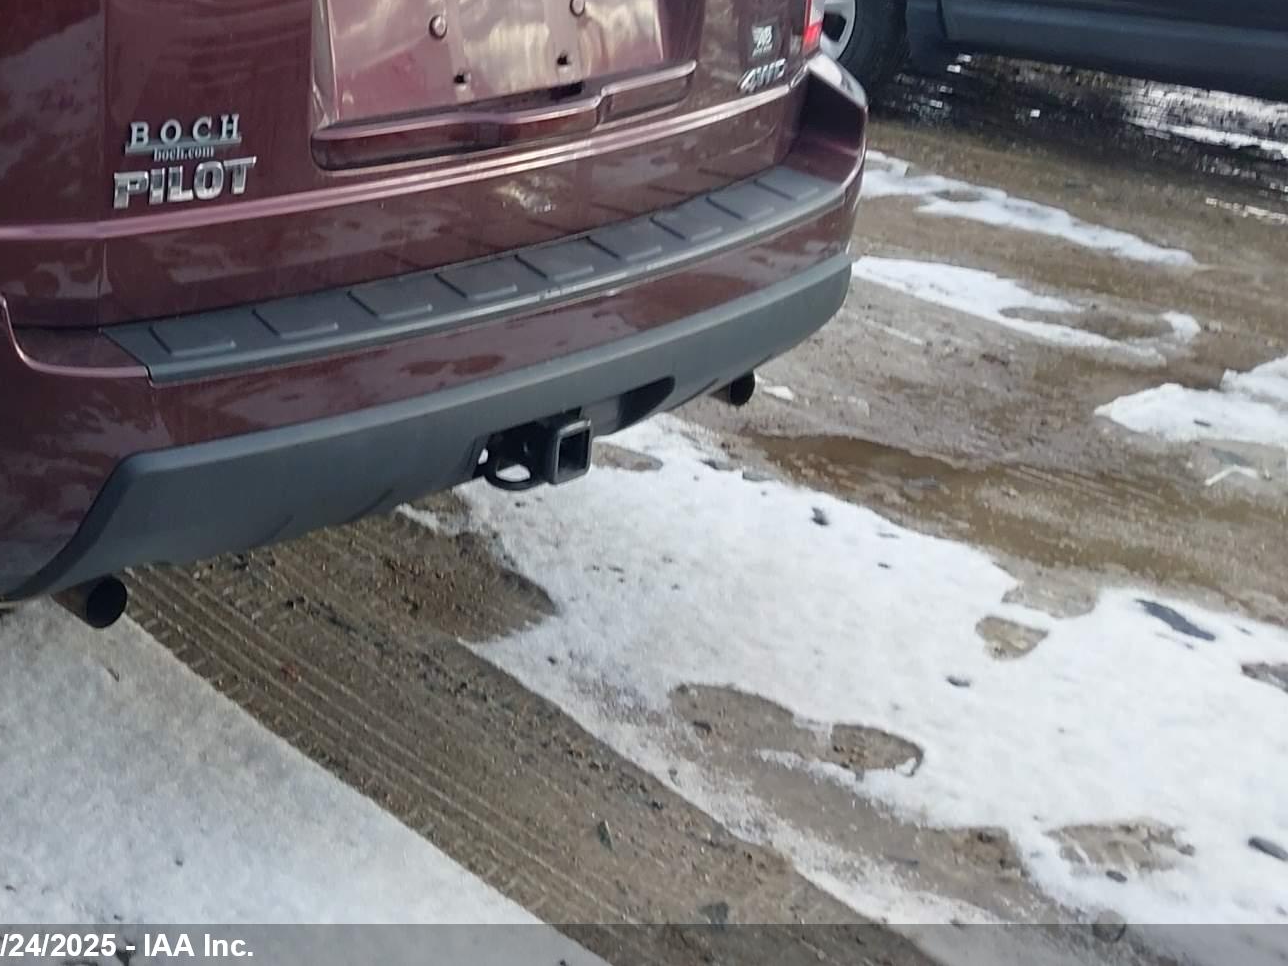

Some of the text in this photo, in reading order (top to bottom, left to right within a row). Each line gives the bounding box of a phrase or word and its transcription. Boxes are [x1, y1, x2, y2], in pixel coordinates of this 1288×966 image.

[130, 113, 239, 147] BOCH
[153, 145, 215, 163] boch.com
[113, 156, 257, 209] PILOT
